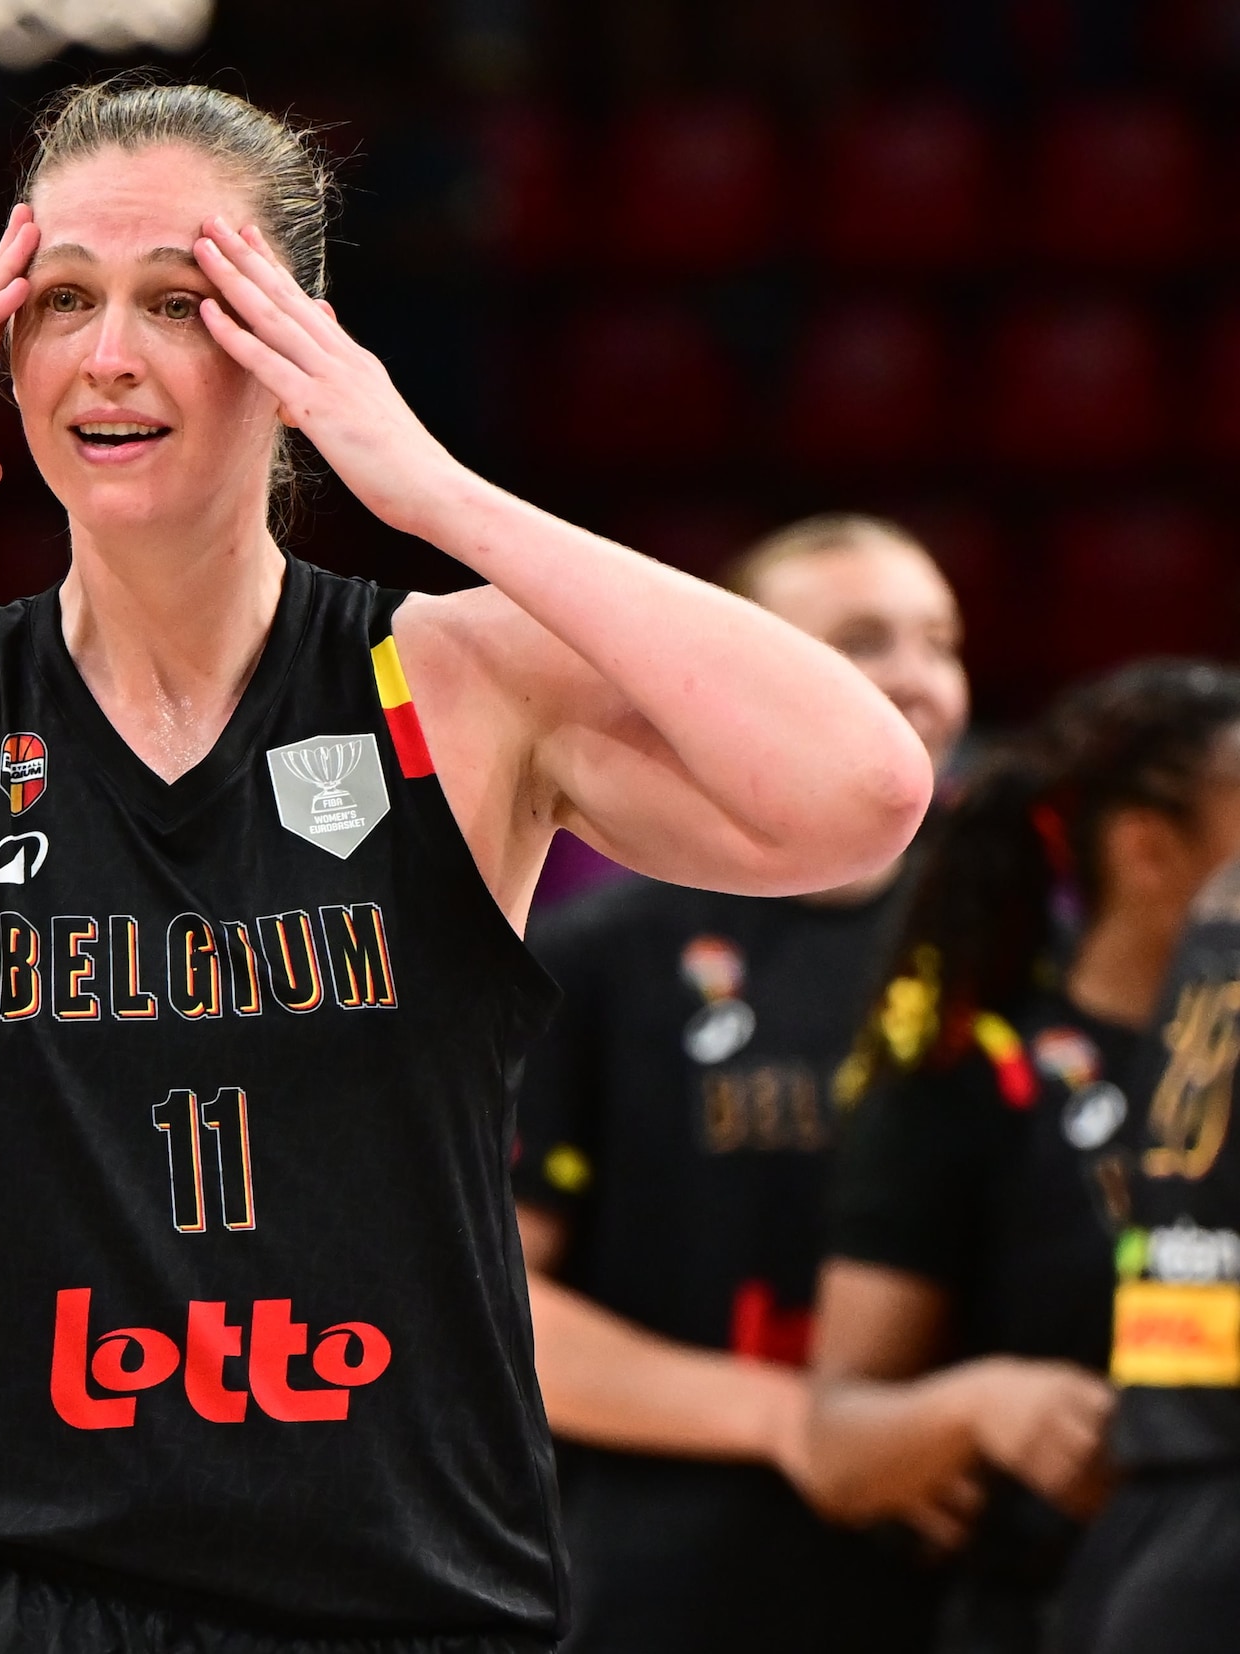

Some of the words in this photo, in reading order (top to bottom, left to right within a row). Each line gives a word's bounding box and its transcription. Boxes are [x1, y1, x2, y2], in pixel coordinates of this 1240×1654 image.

[323, 798, 342, 808] FIBA
[315, 811, 356, 823] WOMEN'S
[309, 818, 365, 833] EUROBASKET
[151, 1086, 256, 1233] 11
[50, 1287, 392, 1430] lotto
